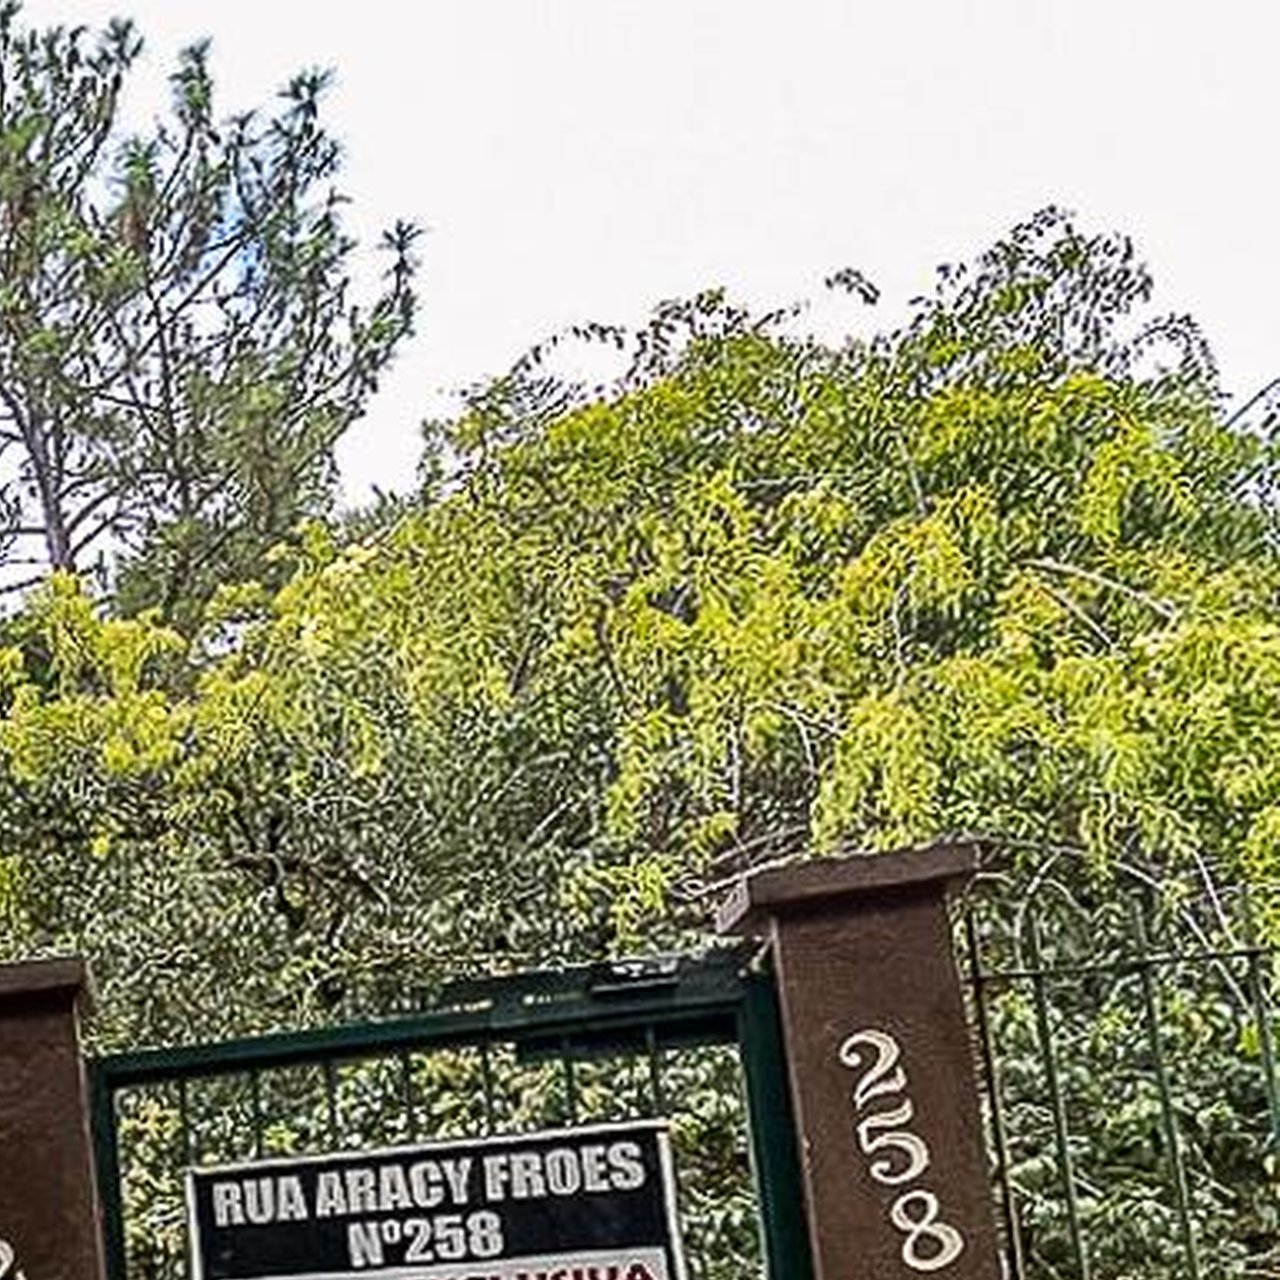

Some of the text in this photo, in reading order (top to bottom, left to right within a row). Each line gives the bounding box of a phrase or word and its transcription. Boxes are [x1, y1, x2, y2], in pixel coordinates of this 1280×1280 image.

[212, 1141, 646, 1228] RUA ARACY FROES
[839, 1028, 965, 1272] 258
